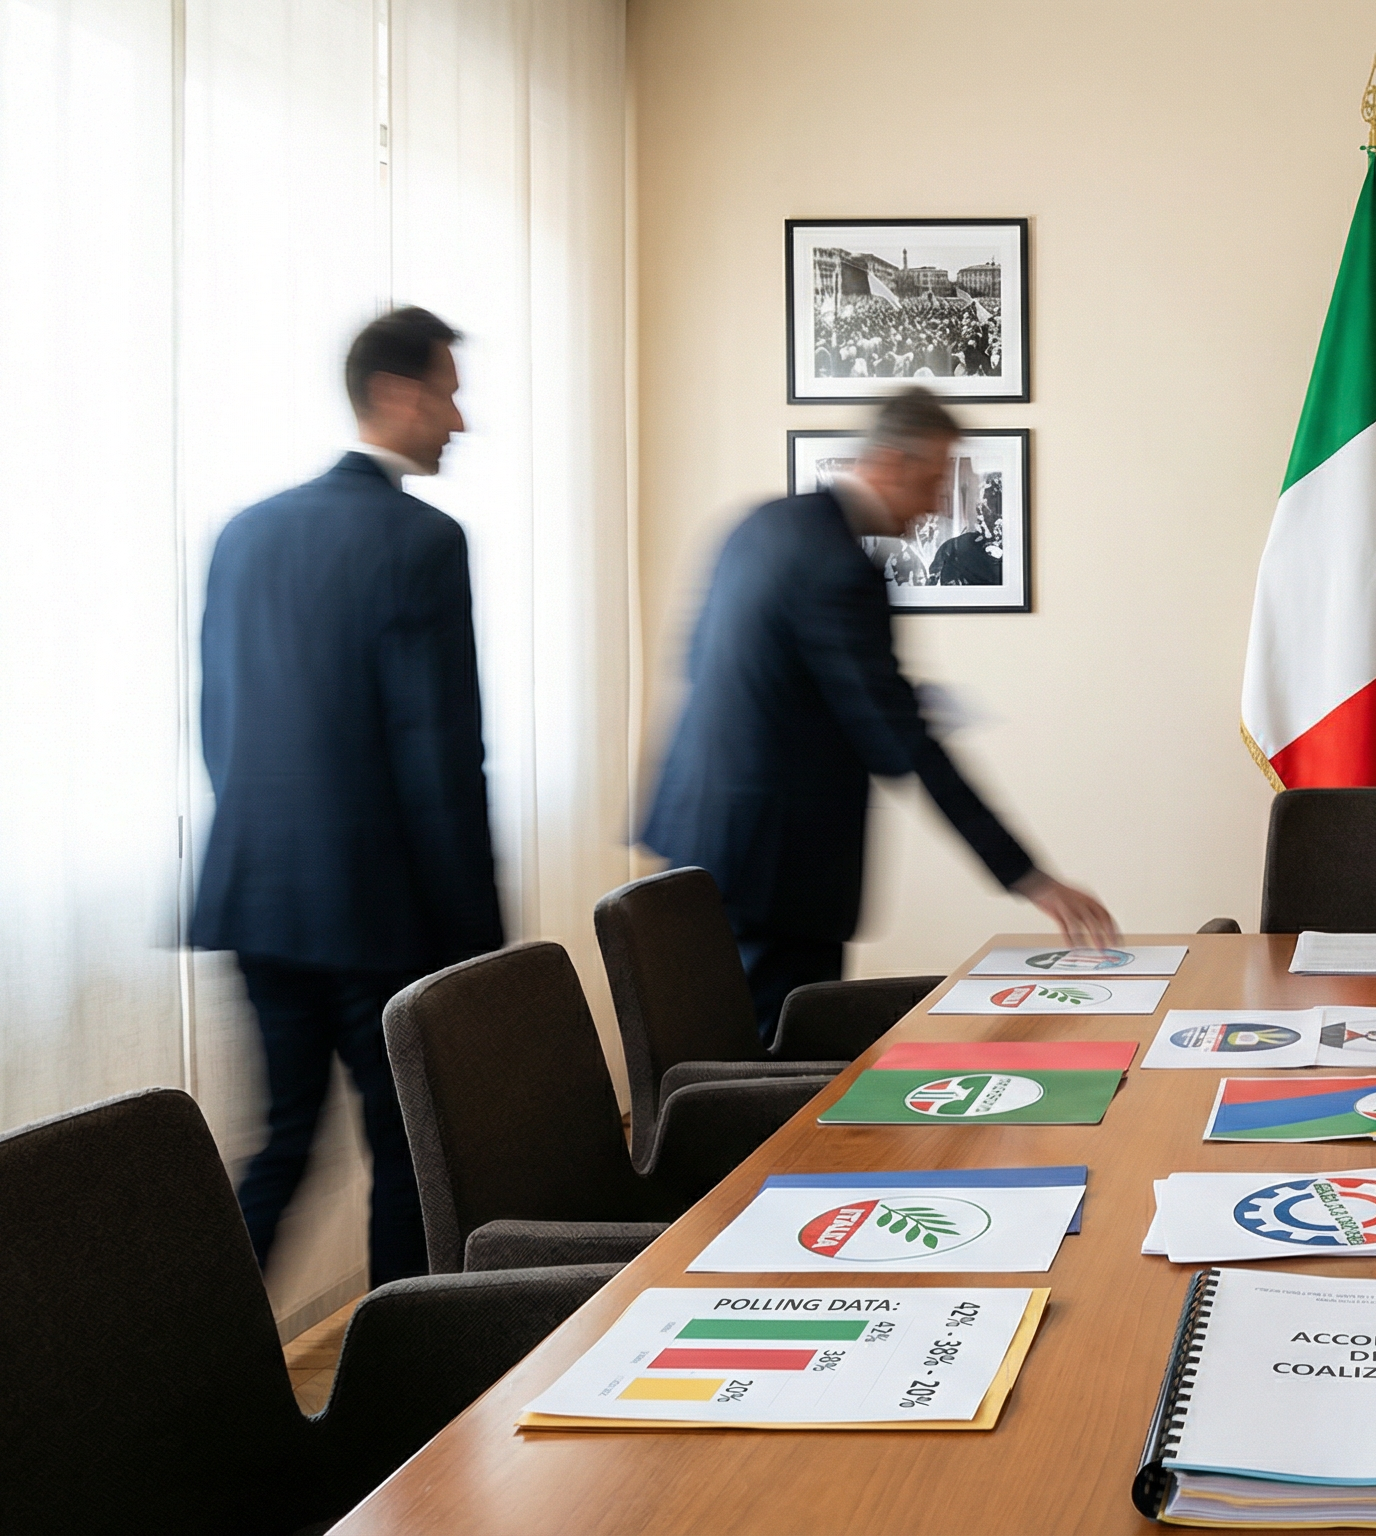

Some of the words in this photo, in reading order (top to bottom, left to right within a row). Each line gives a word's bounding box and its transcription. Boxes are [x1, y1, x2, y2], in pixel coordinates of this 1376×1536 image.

[713, 1298, 823, 1311] POLLING
[827, 1299, 901, 1312] DATA:
[945, 1301, 981, 1328] 42%
[864, 1320, 896, 1343] 42%
[812, 1349, 846, 1372] 38%
[923, 1340, 962, 1367] 38%
[716, 1378, 754, 1404] 20%
[898, 1380, 940, 1408] 20%
